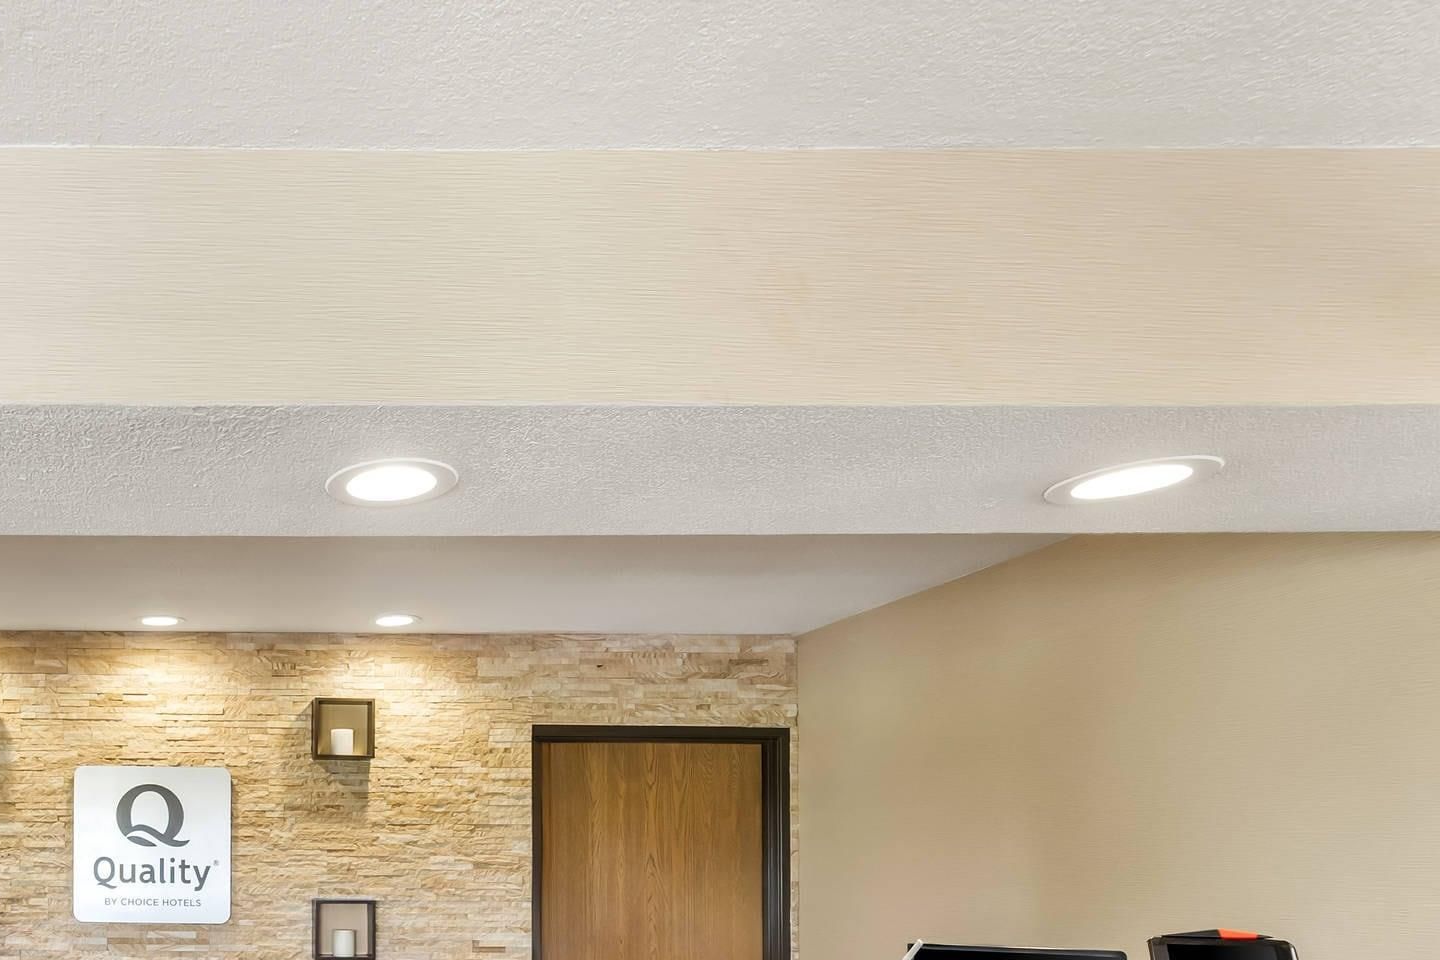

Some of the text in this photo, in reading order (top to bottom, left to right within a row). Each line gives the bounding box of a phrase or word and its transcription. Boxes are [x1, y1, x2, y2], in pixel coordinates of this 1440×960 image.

[116, 783, 190, 848] Q
[93, 856, 211, 892] Quality
[104, 897, 202, 907] BY CHOICE HOTELS
